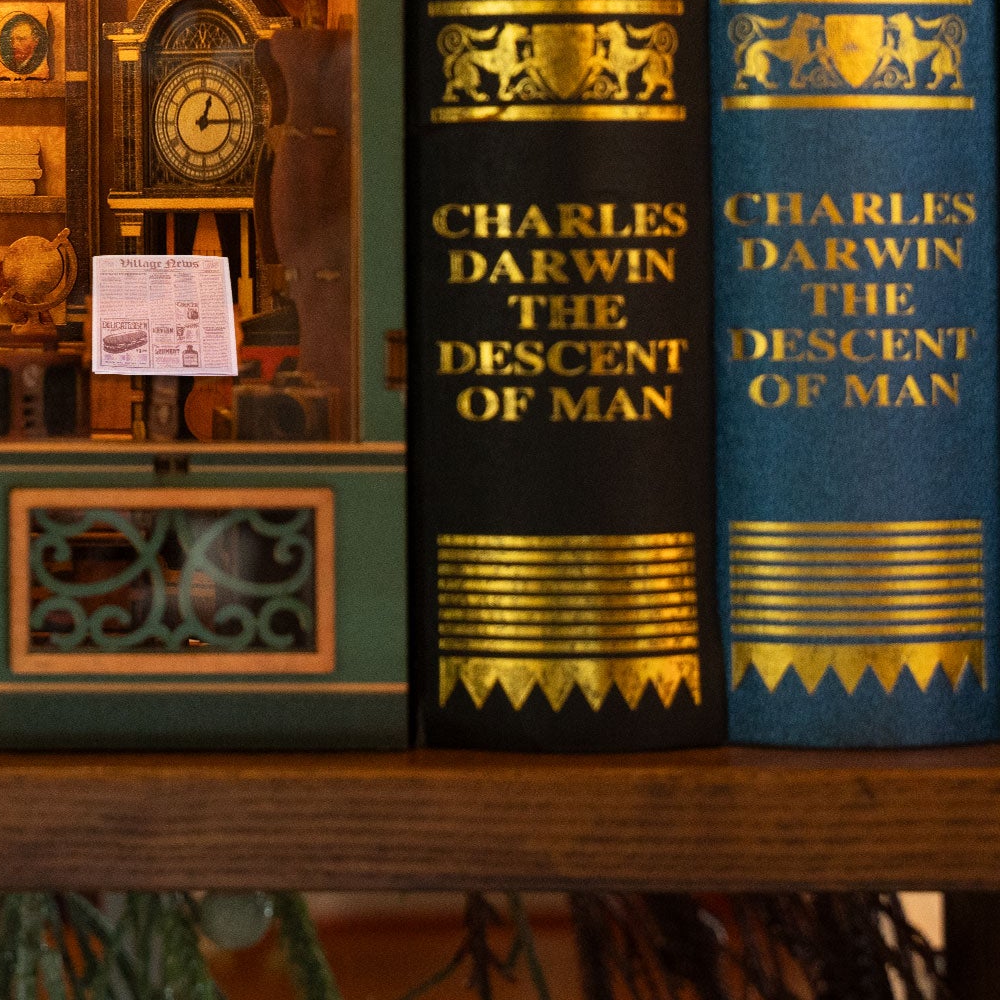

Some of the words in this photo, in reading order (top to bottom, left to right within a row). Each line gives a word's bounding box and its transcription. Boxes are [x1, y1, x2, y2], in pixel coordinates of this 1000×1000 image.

[431, 203, 688, 240] CHARLES
[723, 192, 978, 227] CHARLES
[120, 258, 162, 270] Village
[164, 258, 200, 270] News
[448, 247, 676, 285] DARWIN
[737, 236, 964, 272] DARWIN
[507, 294, 628, 331] THE
[800, 282, 916, 317] THE
[436, 339, 689, 377] DESCENT
[727, 326, 978, 363] DESCENT
[456, 385, 535, 422] OF
[549, 385, 674, 422] MAN
[747, 373, 828, 408] OF
[843, 372, 961, 408] MAN
